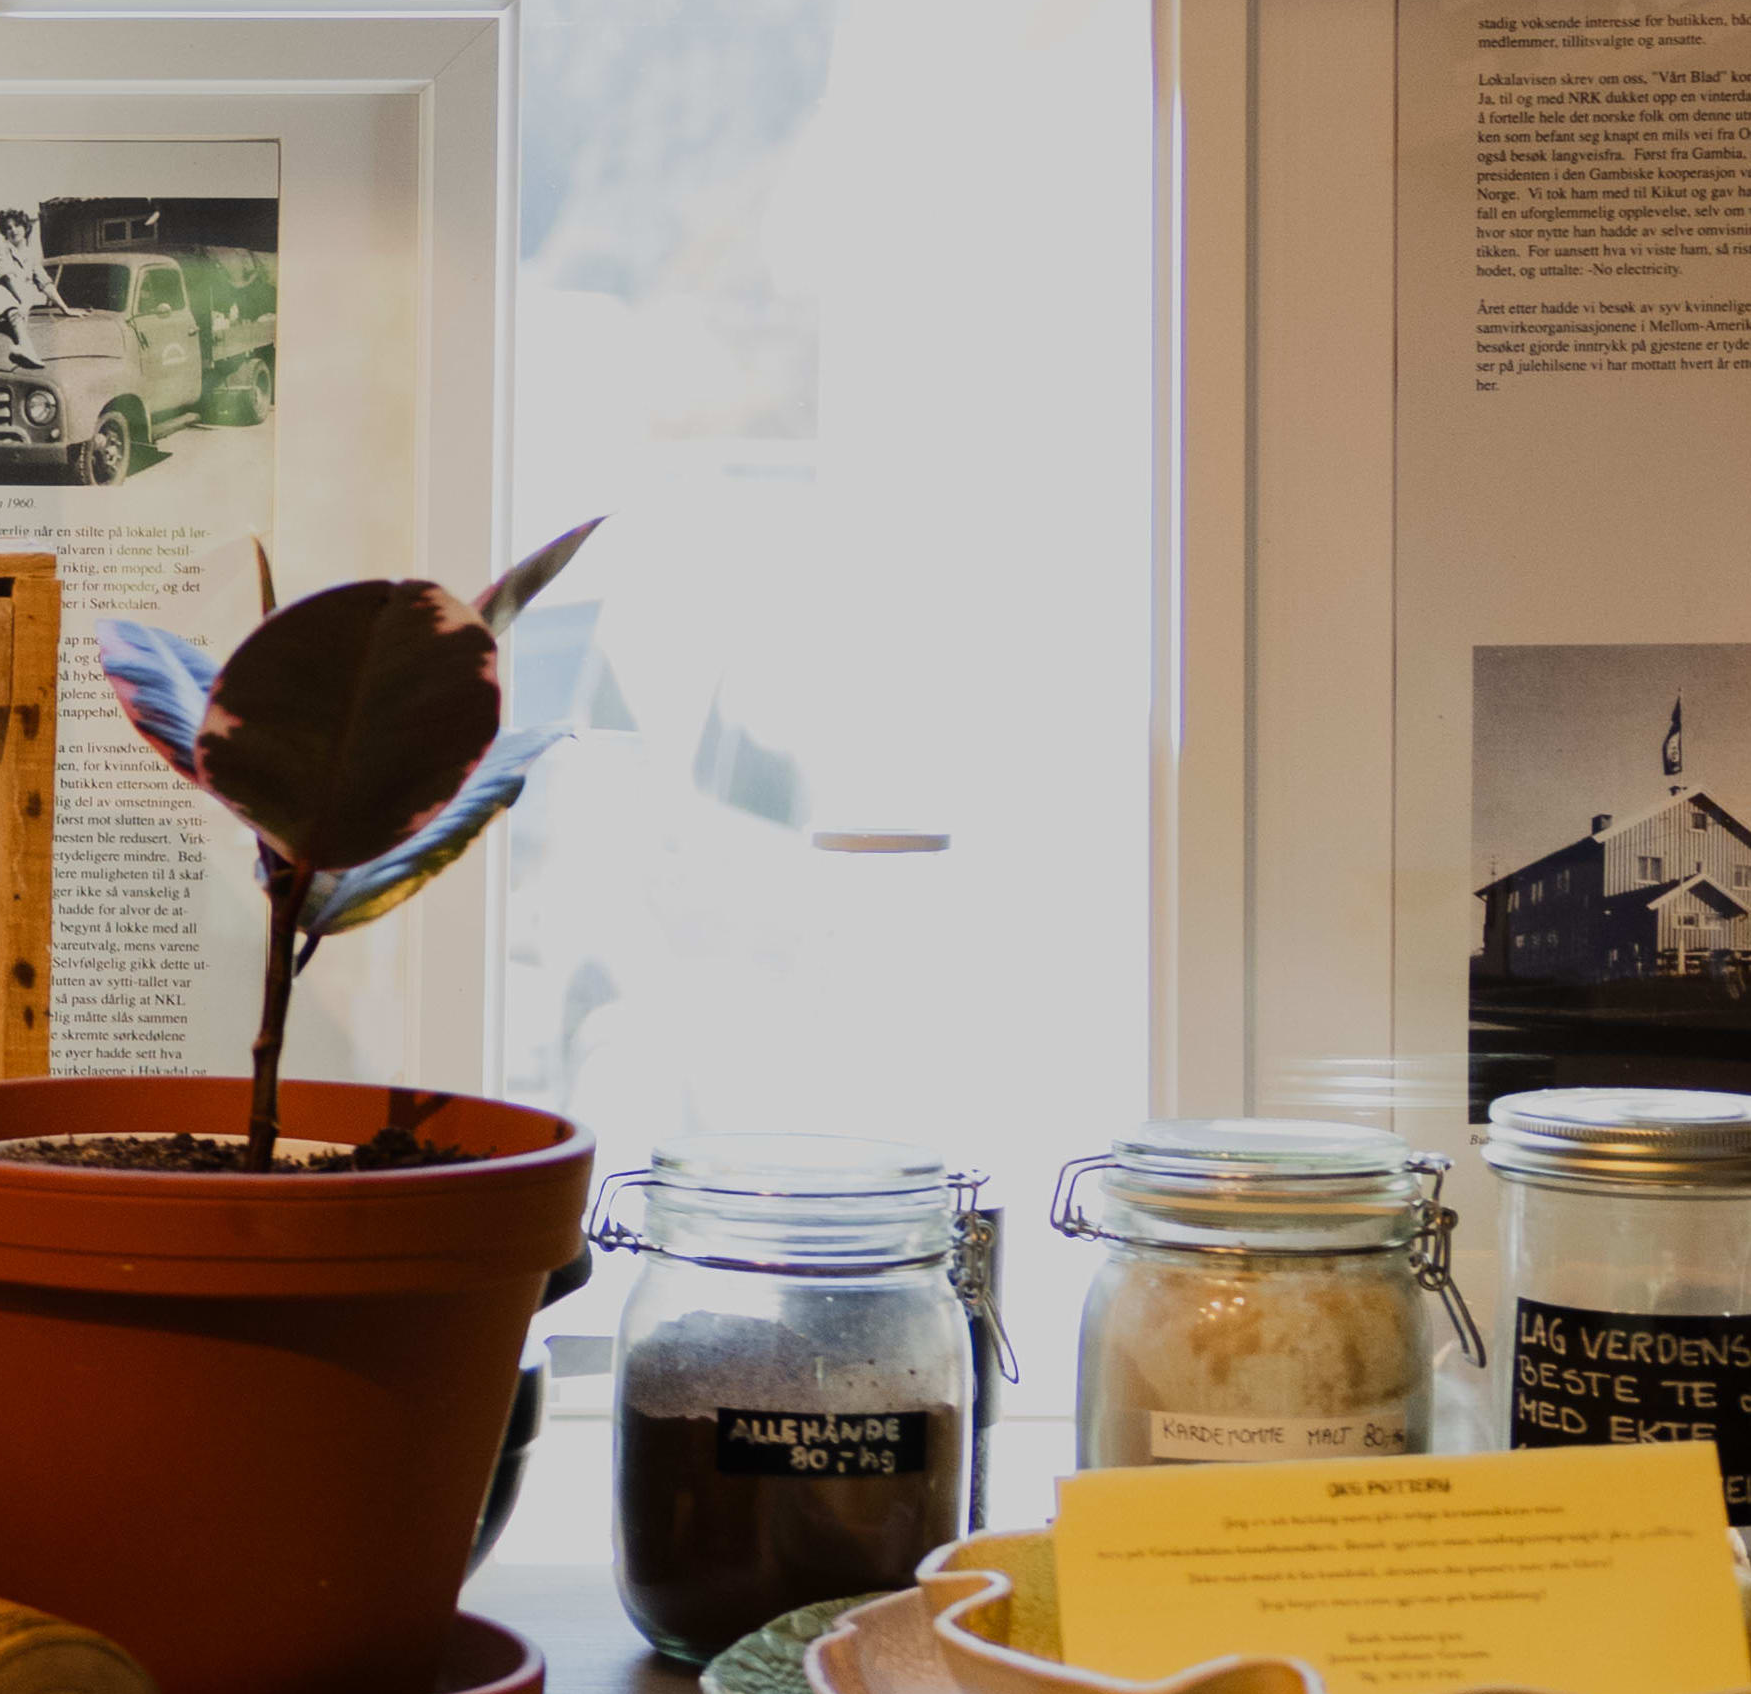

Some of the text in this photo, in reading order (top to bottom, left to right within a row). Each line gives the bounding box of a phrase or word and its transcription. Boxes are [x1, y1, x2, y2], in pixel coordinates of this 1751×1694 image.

[1477, 33, 1706, 52] medlemmer, tillitsvalgte og ansatte.
[1475, 263, 1517, 278] hodet,
[1518, 266, 1536, 281] og
[1539, 262, 1584, 278] uttalte:
[1615, 261, 1683, 279] electricity.
[6, 496, 37, 509] 1960.
[60, 920, 198, 936] begynt å lokke med all
[1520, 1311, 1751, 1370] LAG VERDENS
[1518, 1355, 1718, 1408] BESTE TE
[728, 1411, 902, 1446] ALLEHÅNDE
[1518, 1394, 1588, 1435] MED
[1162, 1419, 1285, 1446] KARDEMOMME
[1306, 1425, 1353, 1447] MALT
